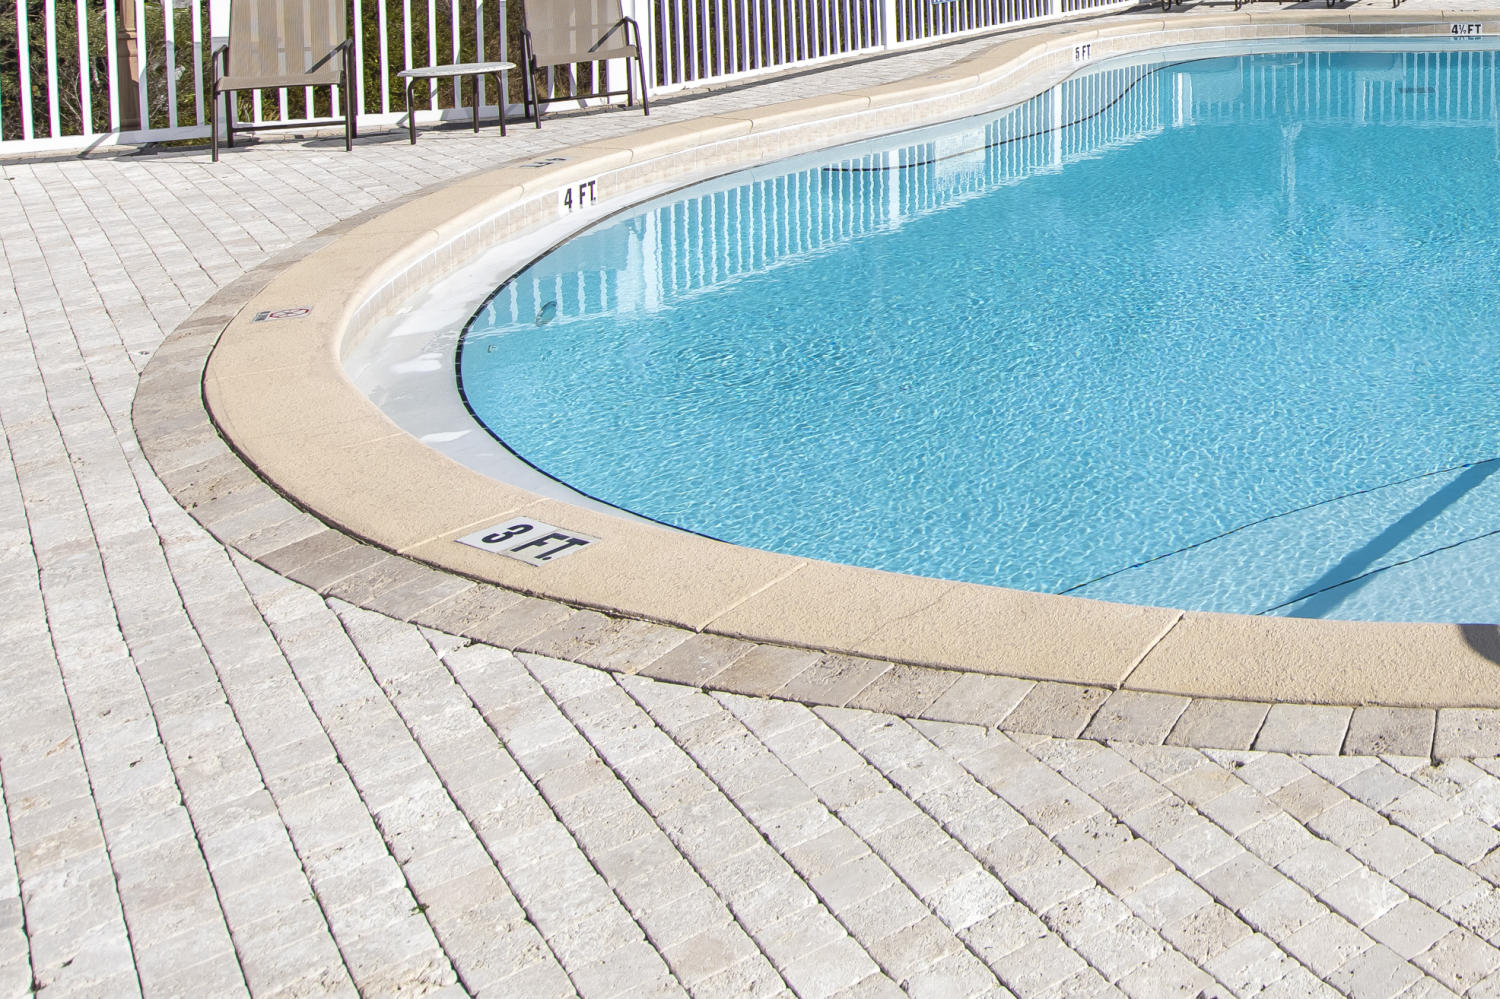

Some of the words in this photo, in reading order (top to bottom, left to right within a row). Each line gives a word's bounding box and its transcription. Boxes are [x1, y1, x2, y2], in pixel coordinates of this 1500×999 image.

[1468, 24, 1482, 34] FT
[1082, 44, 1091, 57] FT
[564, 188, 573, 208] 4
[579, 180, 596, 205] FT.
[481, 524, 534, 544] 3
[509, 532, 591, 560] FT.
